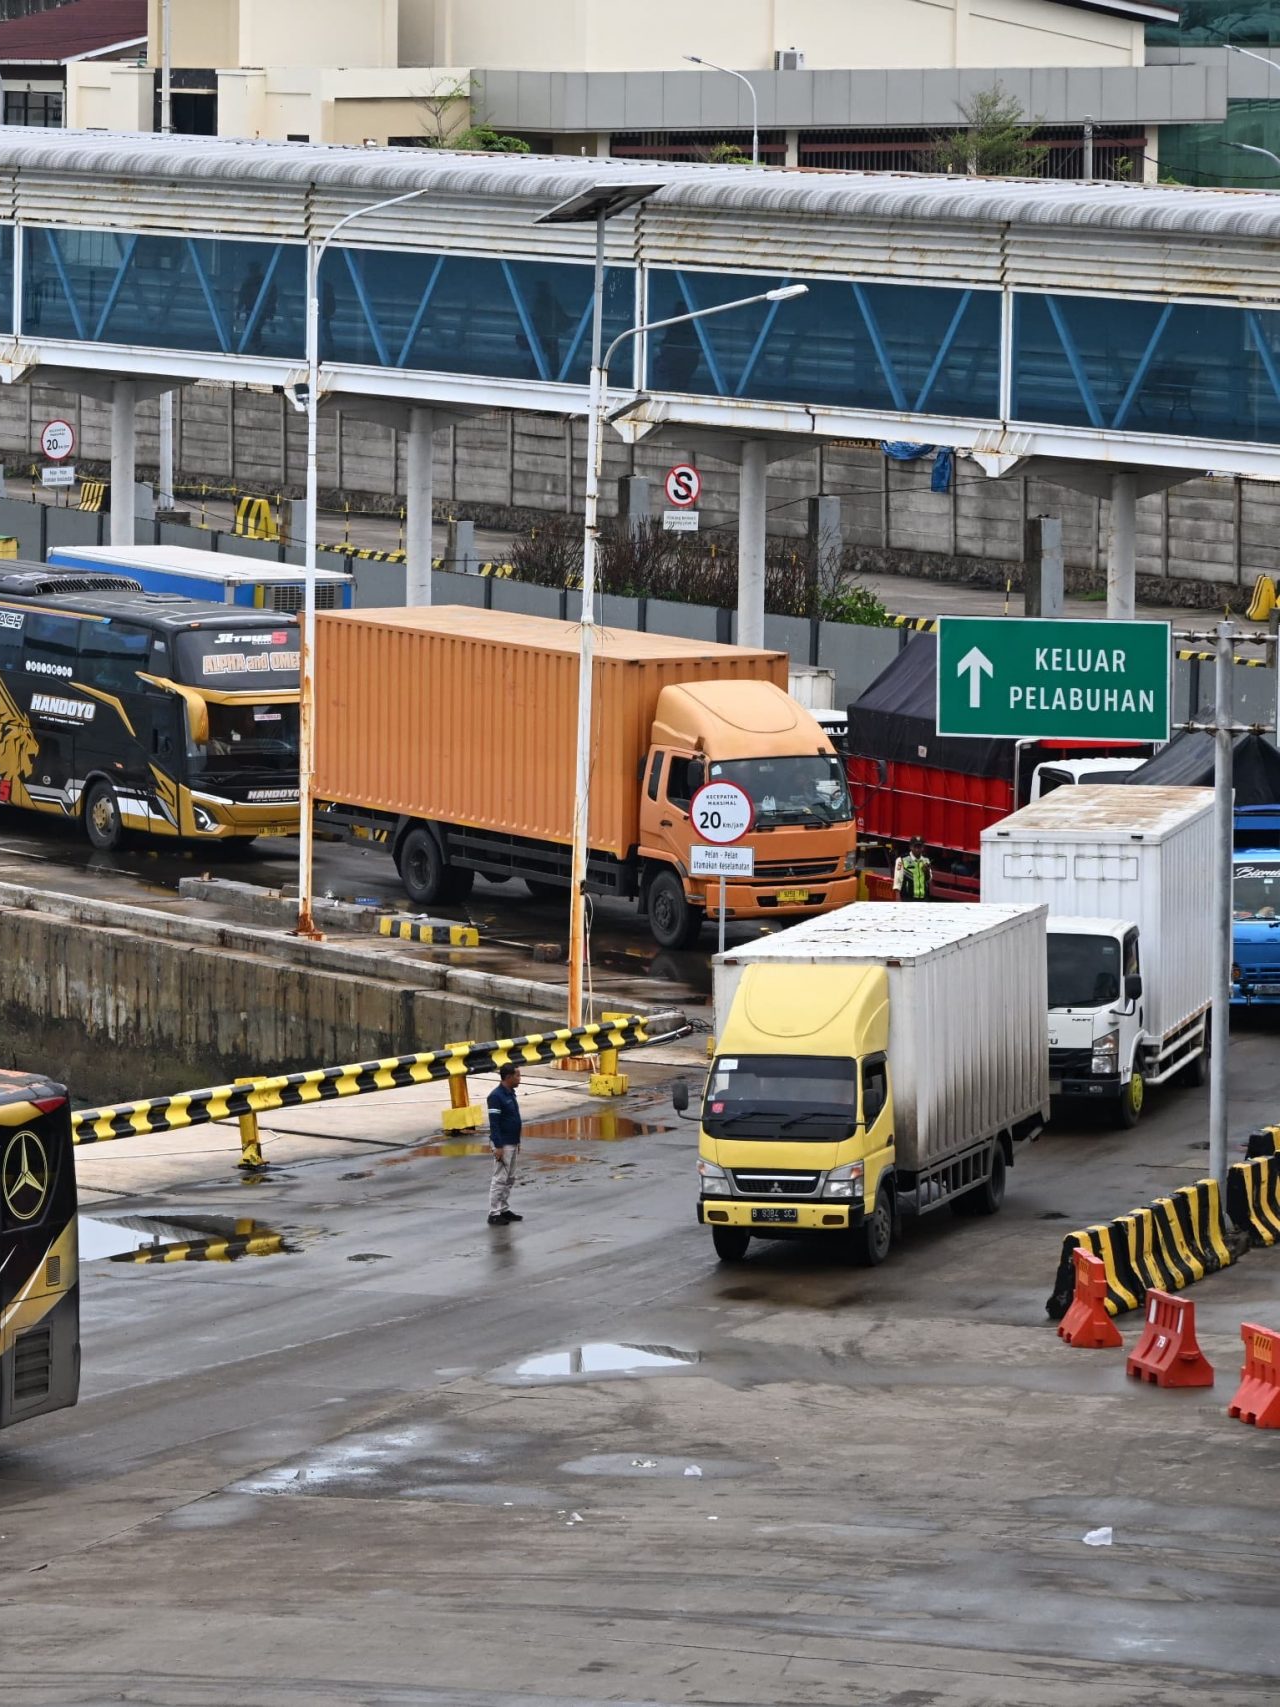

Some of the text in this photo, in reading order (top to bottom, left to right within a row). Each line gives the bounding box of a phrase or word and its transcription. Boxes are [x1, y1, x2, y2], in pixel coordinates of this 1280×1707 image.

[46, 439, 58, 450] 20
[673, 471, 693, 500] S
[203, 654, 246, 674] ALPHA
[248, 653, 269, 670] and
[1035, 648, 1126, 673] KELUAR
[30, 694, 95, 720] HANDOYO
[1010, 686, 1154, 713] PELABUHAN
[700, 811, 721, 829] 20
[705, 850, 718, 859] Pelan
[724, 851, 738, 859] Pelan
[693, 861, 750, 871] Utamakan Keselamatan
